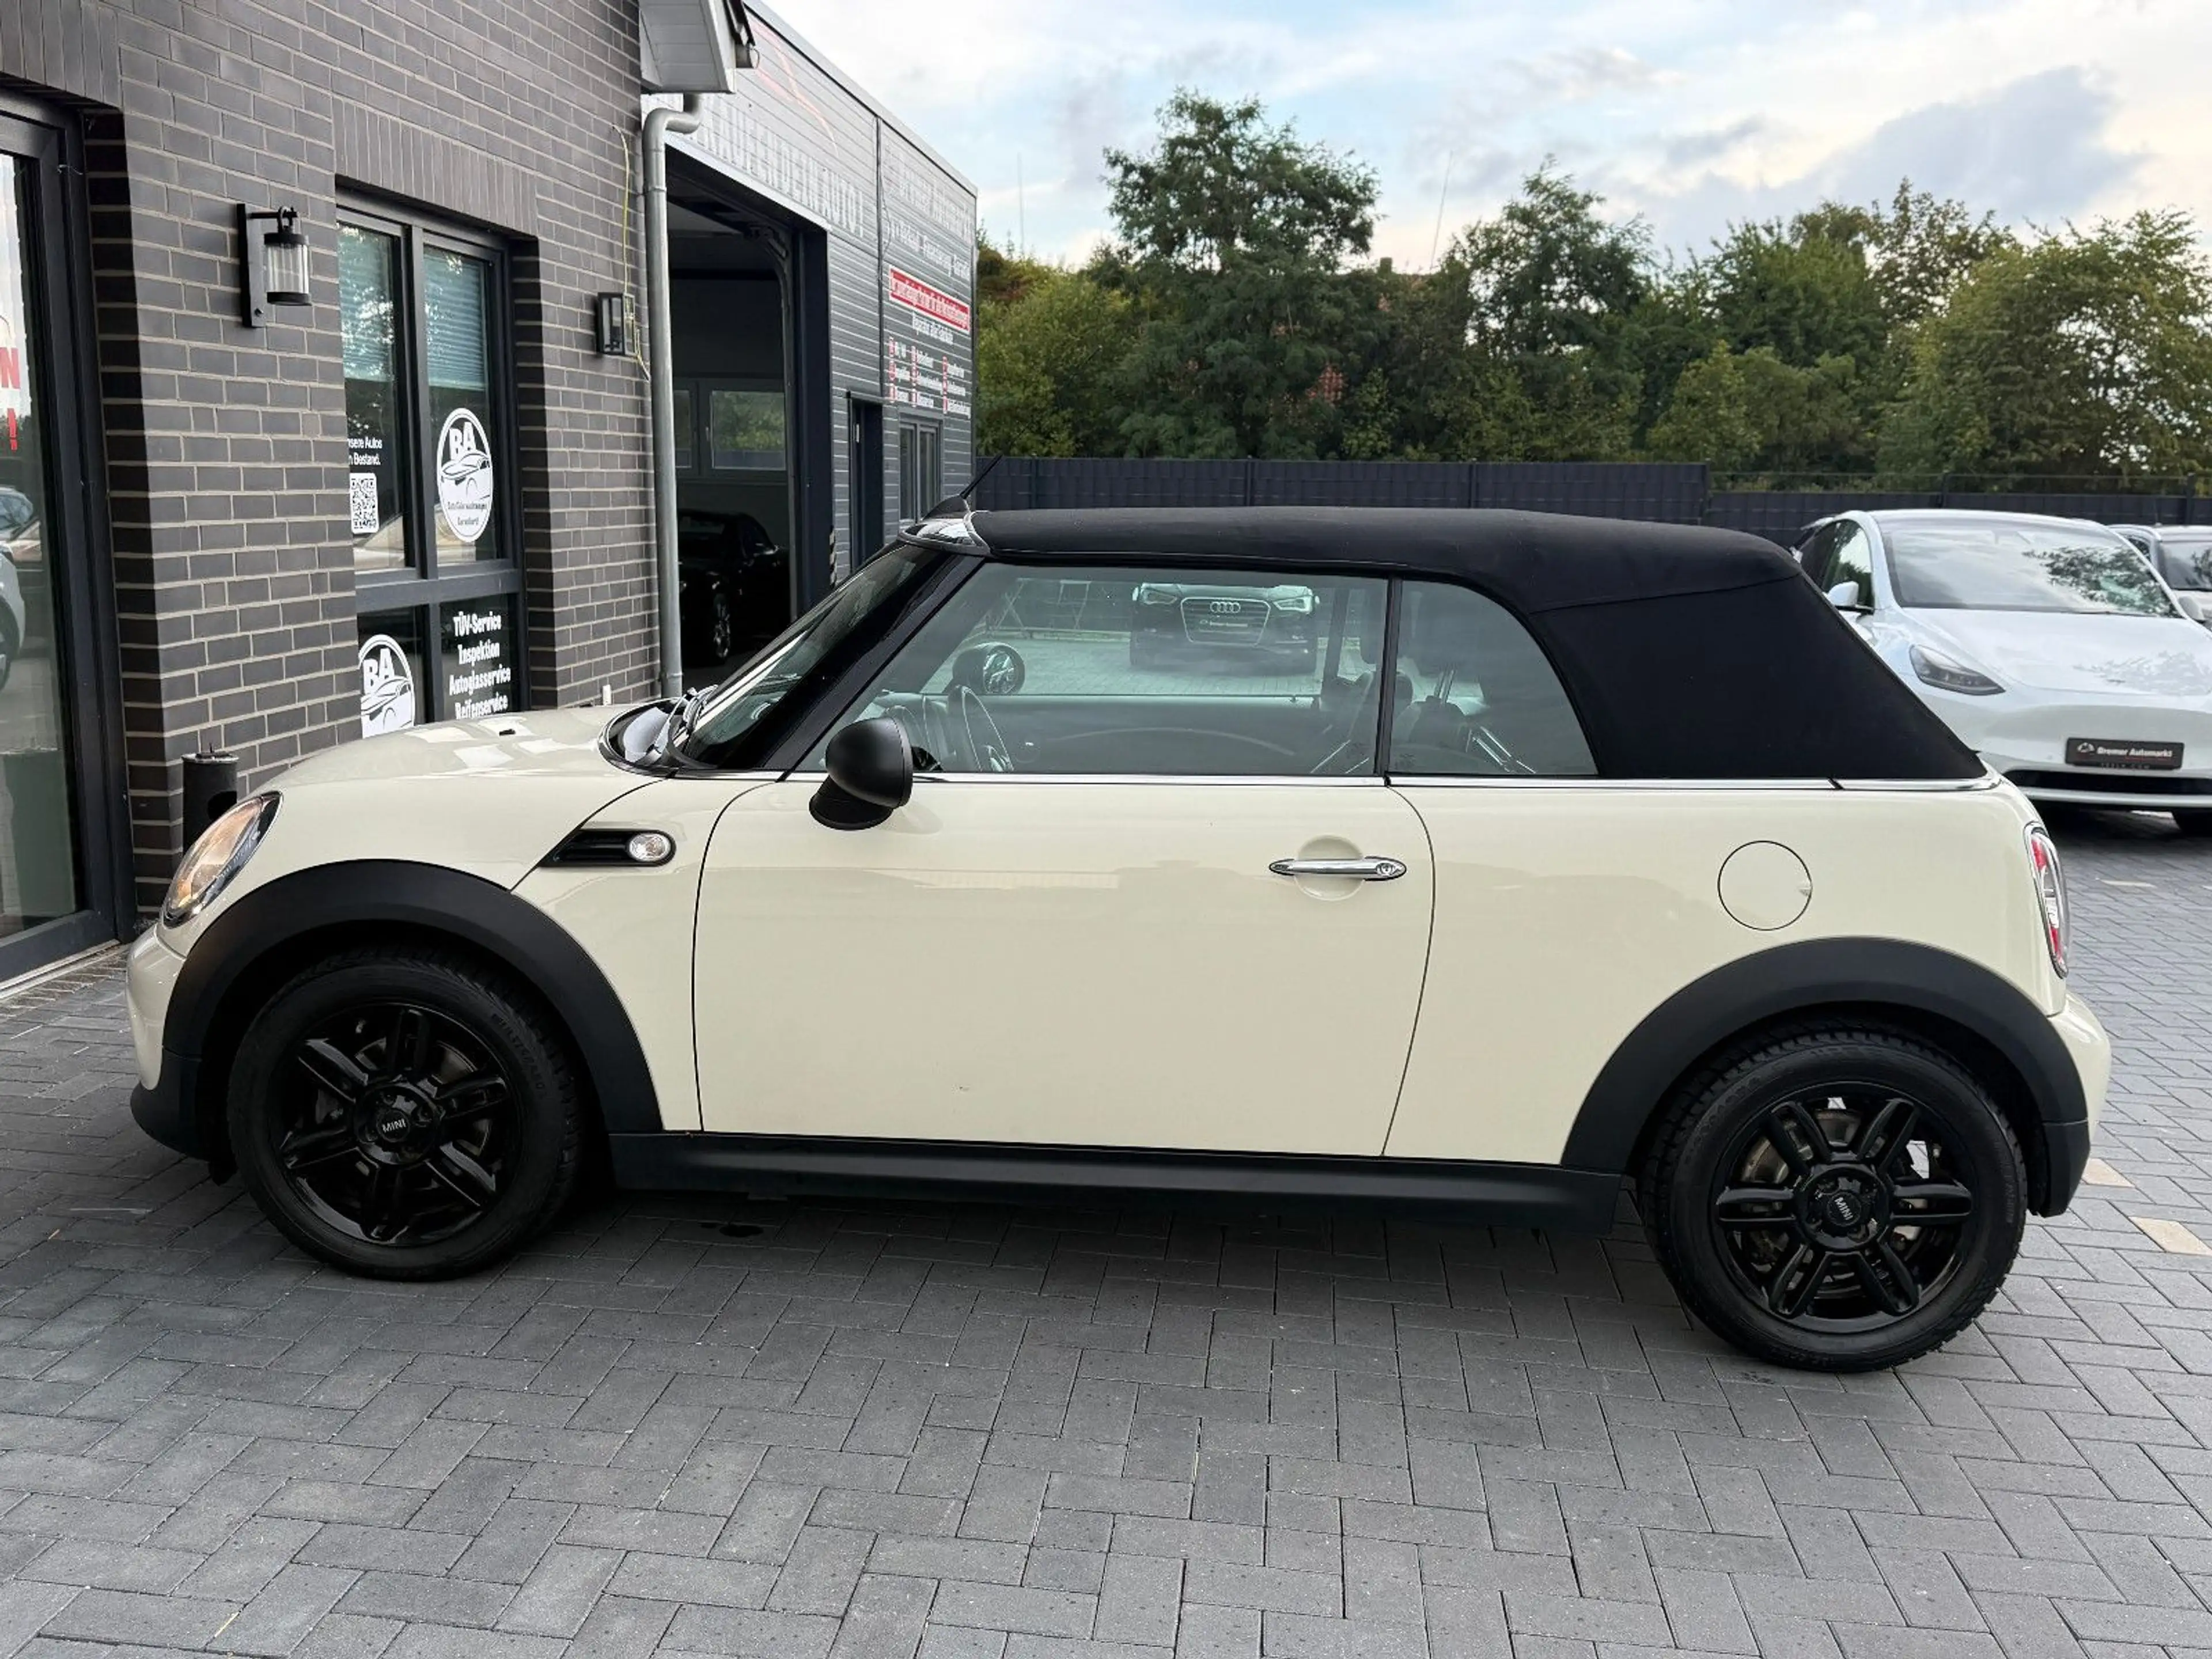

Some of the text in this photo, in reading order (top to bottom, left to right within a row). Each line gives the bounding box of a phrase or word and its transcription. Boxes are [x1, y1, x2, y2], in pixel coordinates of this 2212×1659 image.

[365, 436, 382, 449] Autos
[449, 421, 477, 460] BA
[354, 452, 381, 465] Bestand.
[453, 611, 502, 637] TÜV-Service
[458, 639, 500, 666] Inspektion
[363, 648, 395, 695] BA
[449, 664, 511, 695] Autoglasservice
[454, 692, 509, 719] Reifenservice
[382, 1118, 406, 1133] MINI
[1834, 1197, 1853, 1220] MINI
